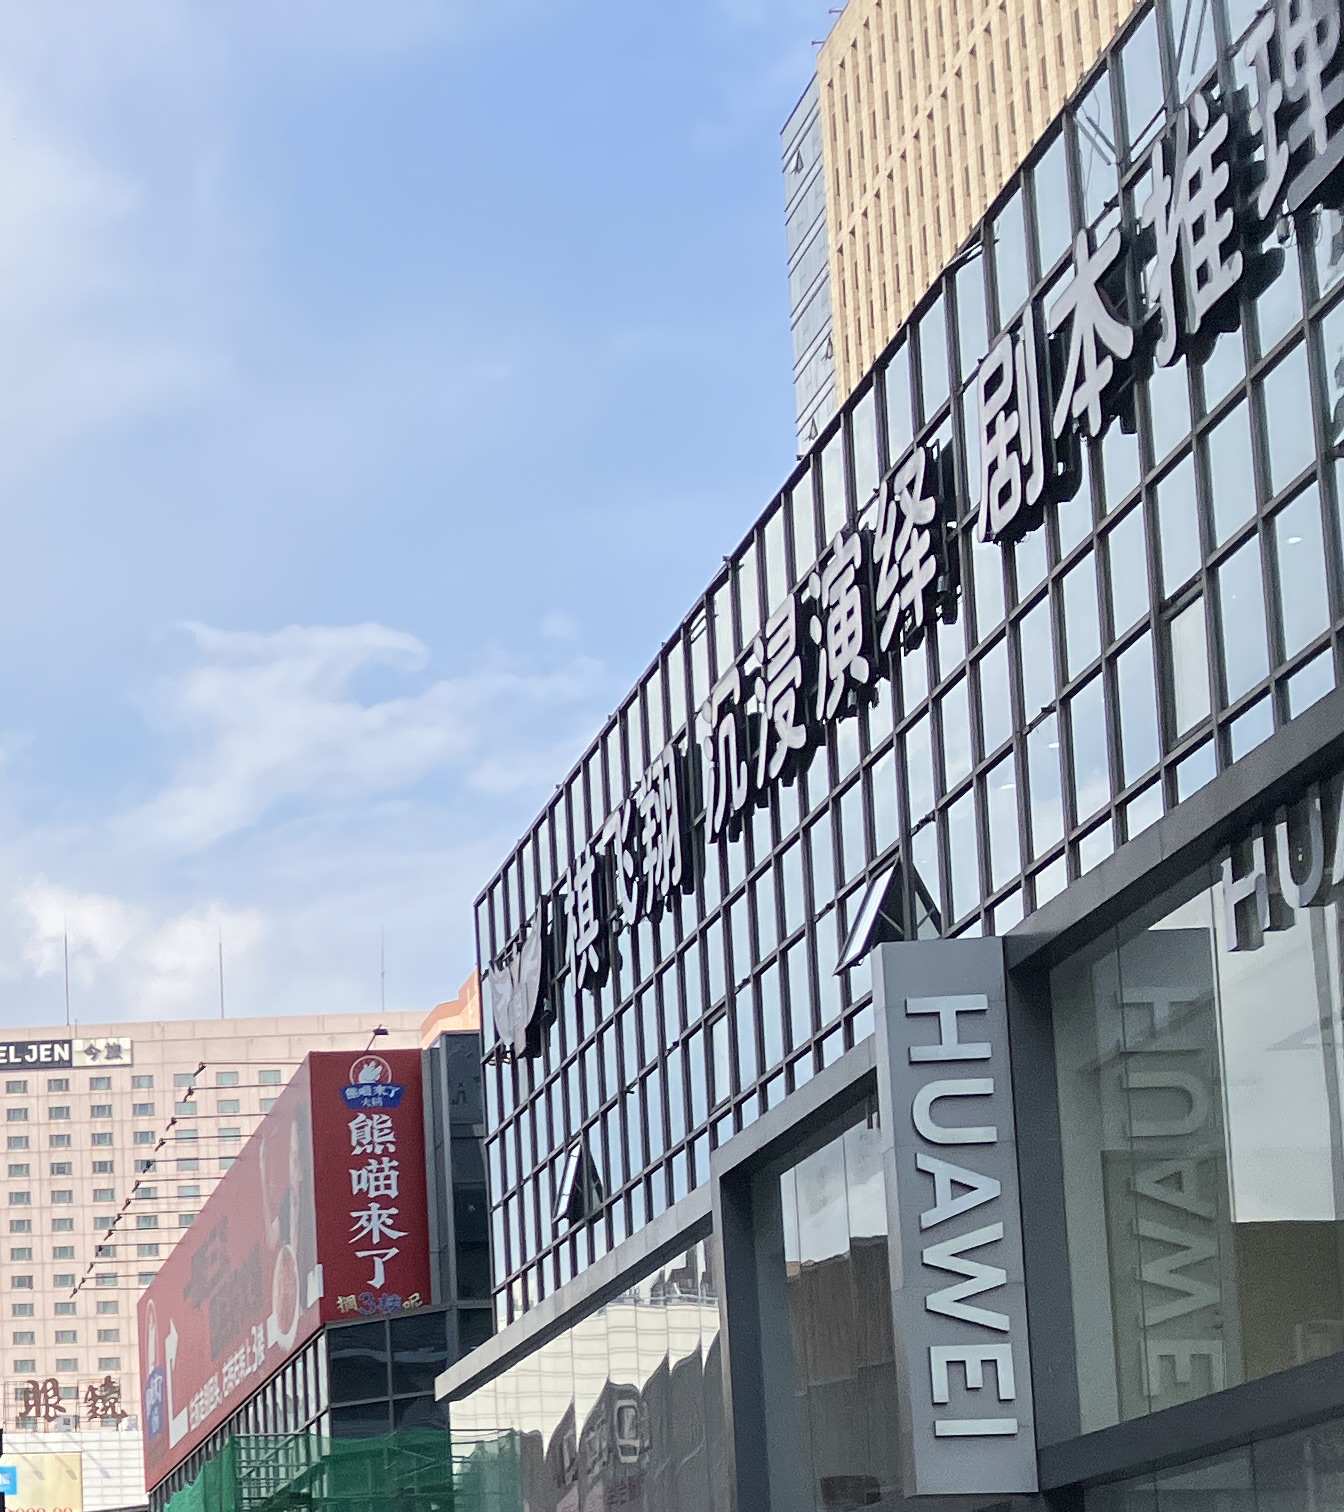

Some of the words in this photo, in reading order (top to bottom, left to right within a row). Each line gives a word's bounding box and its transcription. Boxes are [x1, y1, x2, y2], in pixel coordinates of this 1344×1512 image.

[1219, 780, 1344, 953] HU
[25, 1043, 70, 1063] JEN
[348, 1113, 409, 1289] 熊喵來了
[905, 994, 1019, 1438] HUAWEI
